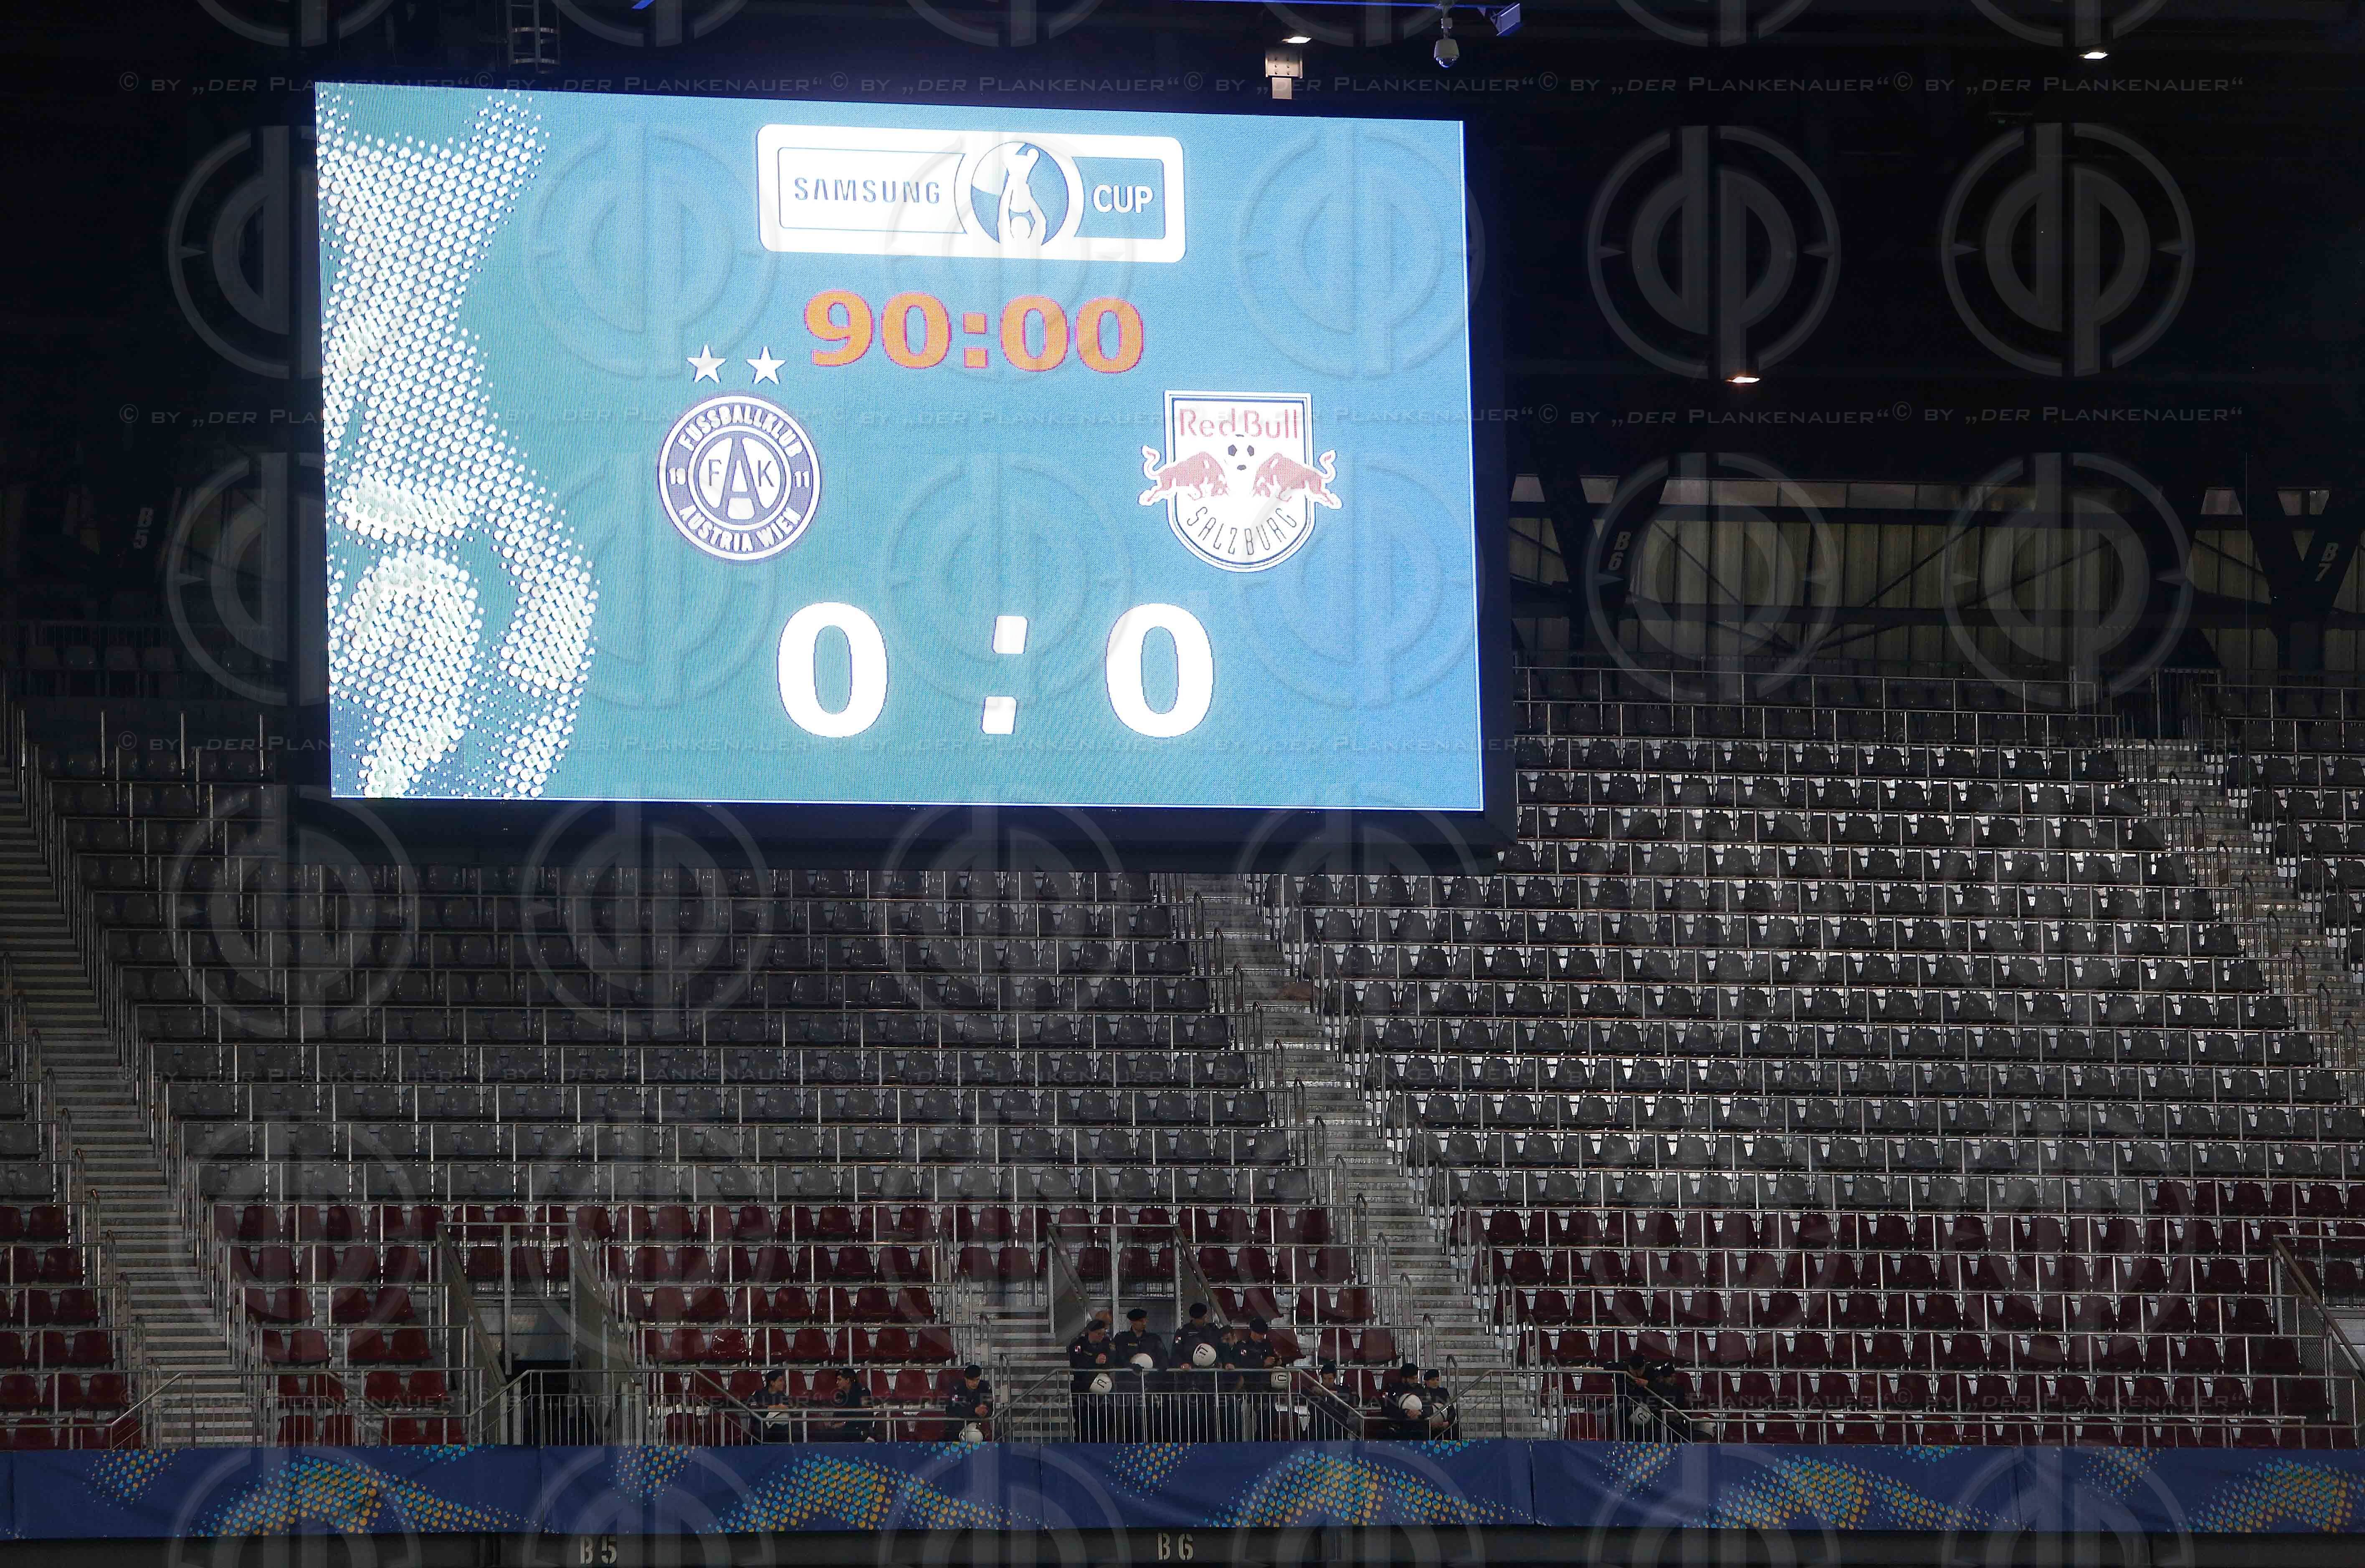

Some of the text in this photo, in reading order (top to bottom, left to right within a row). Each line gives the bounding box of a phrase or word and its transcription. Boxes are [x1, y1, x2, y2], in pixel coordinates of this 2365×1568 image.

[794, 176, 941, 204] SAMSUNG
[1091, 184, 1154, 214] CUP
[803, 289, 1145, 374] 90:00
[677, 404, 804, 458] FUSSBALLKLUB
[1179, 407, 1236, 437] Red
[1244, 409, 1297, 439] Bull
[678, 504, 802, 552] AUSTRIA WIEN
[1186, 506, 1297, 556] SALZBURG
[777, 601, 889, 738] 0
[1105, 602, 1215, 738] 0
